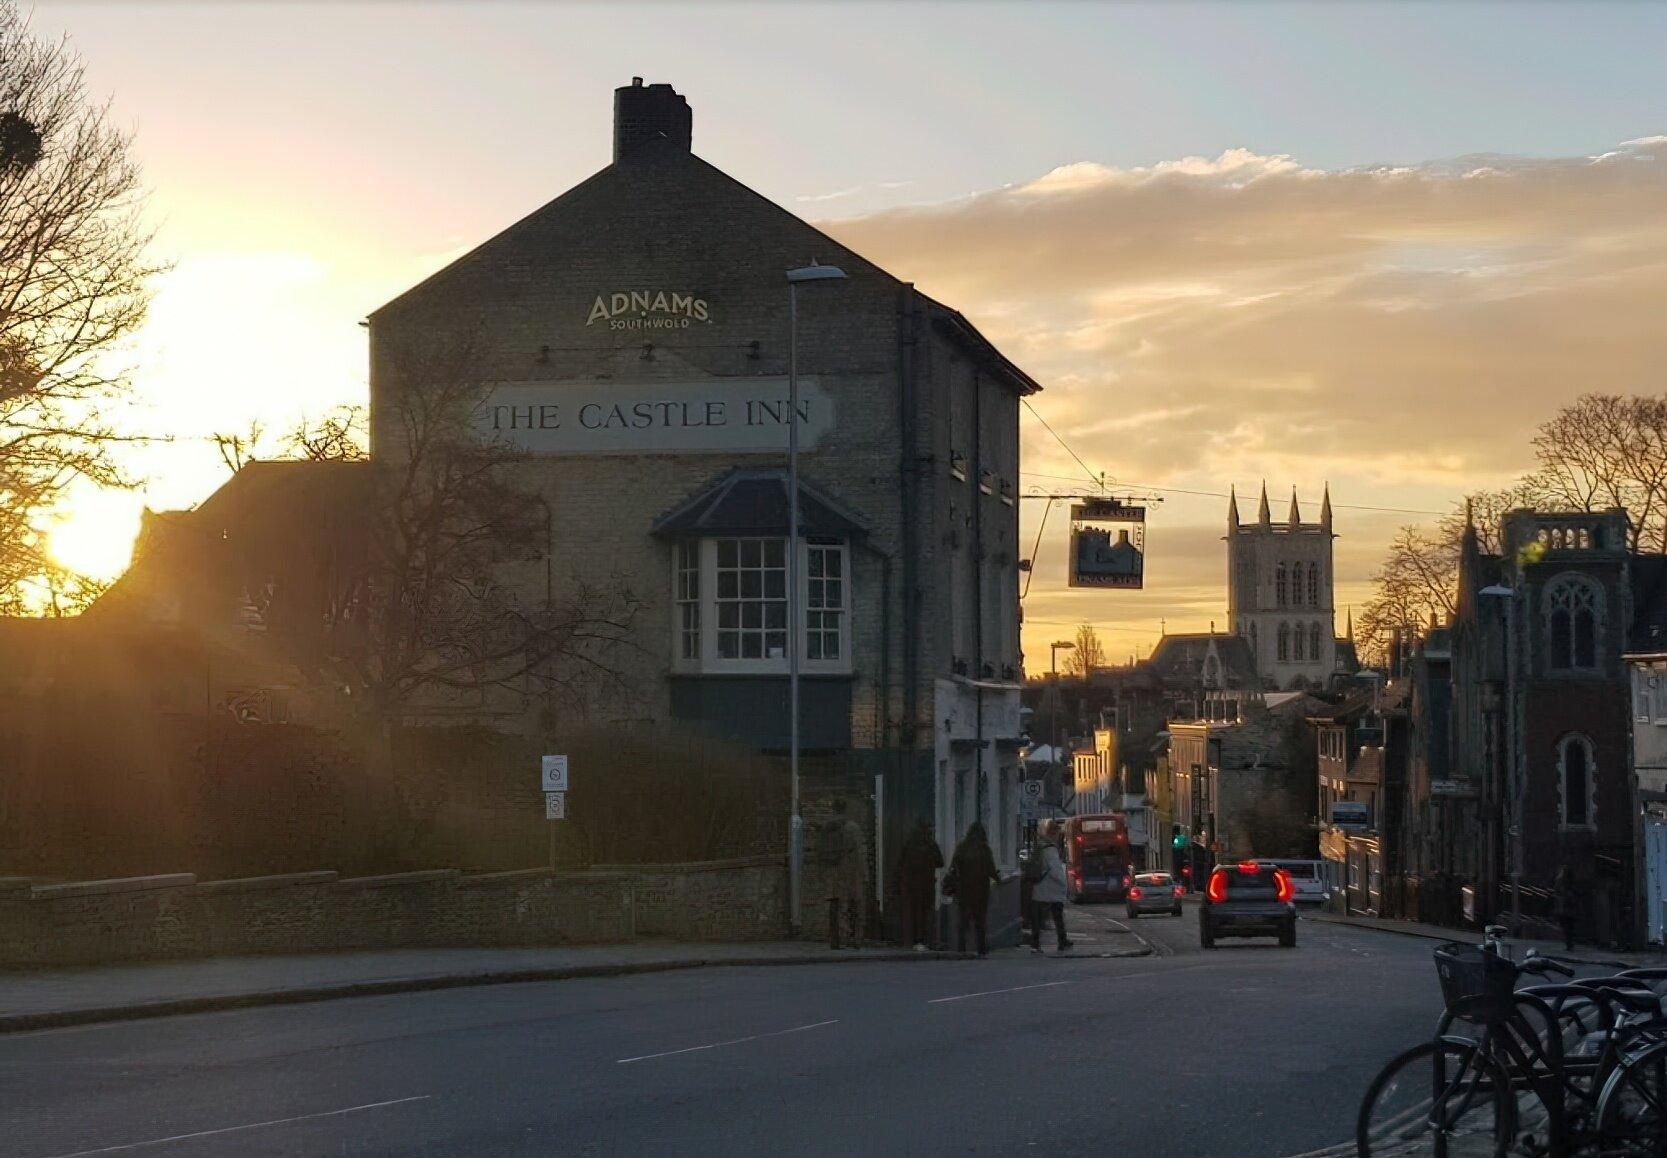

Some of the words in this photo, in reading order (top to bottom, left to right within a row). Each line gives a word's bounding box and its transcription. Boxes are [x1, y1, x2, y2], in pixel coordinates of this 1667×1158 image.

[585, 290, 709, 327] ADNAMS
[610, 318, 690, 330] SOUTHWOLD
[491, 404, 561, 430] THE
[578, 401, 728, 429] CASTLE
[745, 400, 809, 426] INN
